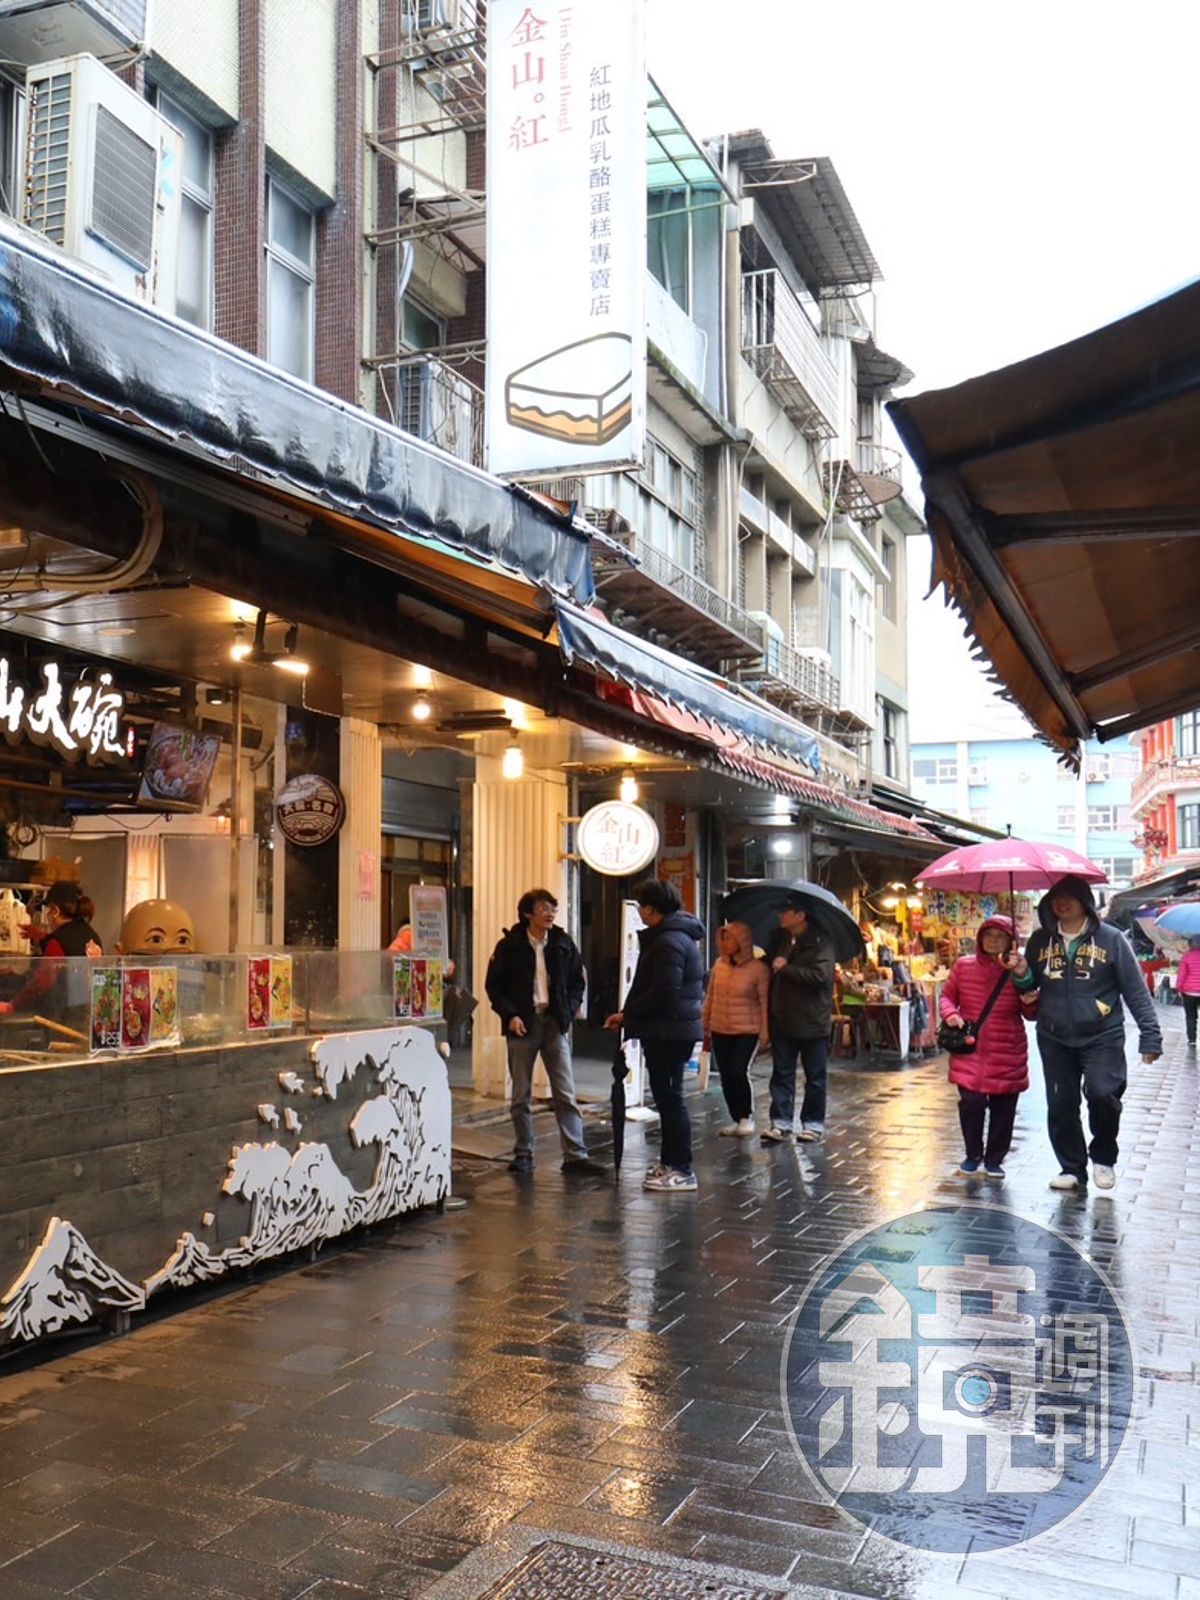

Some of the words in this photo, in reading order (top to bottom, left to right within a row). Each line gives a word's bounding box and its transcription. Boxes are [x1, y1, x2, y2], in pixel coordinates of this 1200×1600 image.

[589, 64, 611, 317] 紅地瓜乳酪蛋糕專賣店
